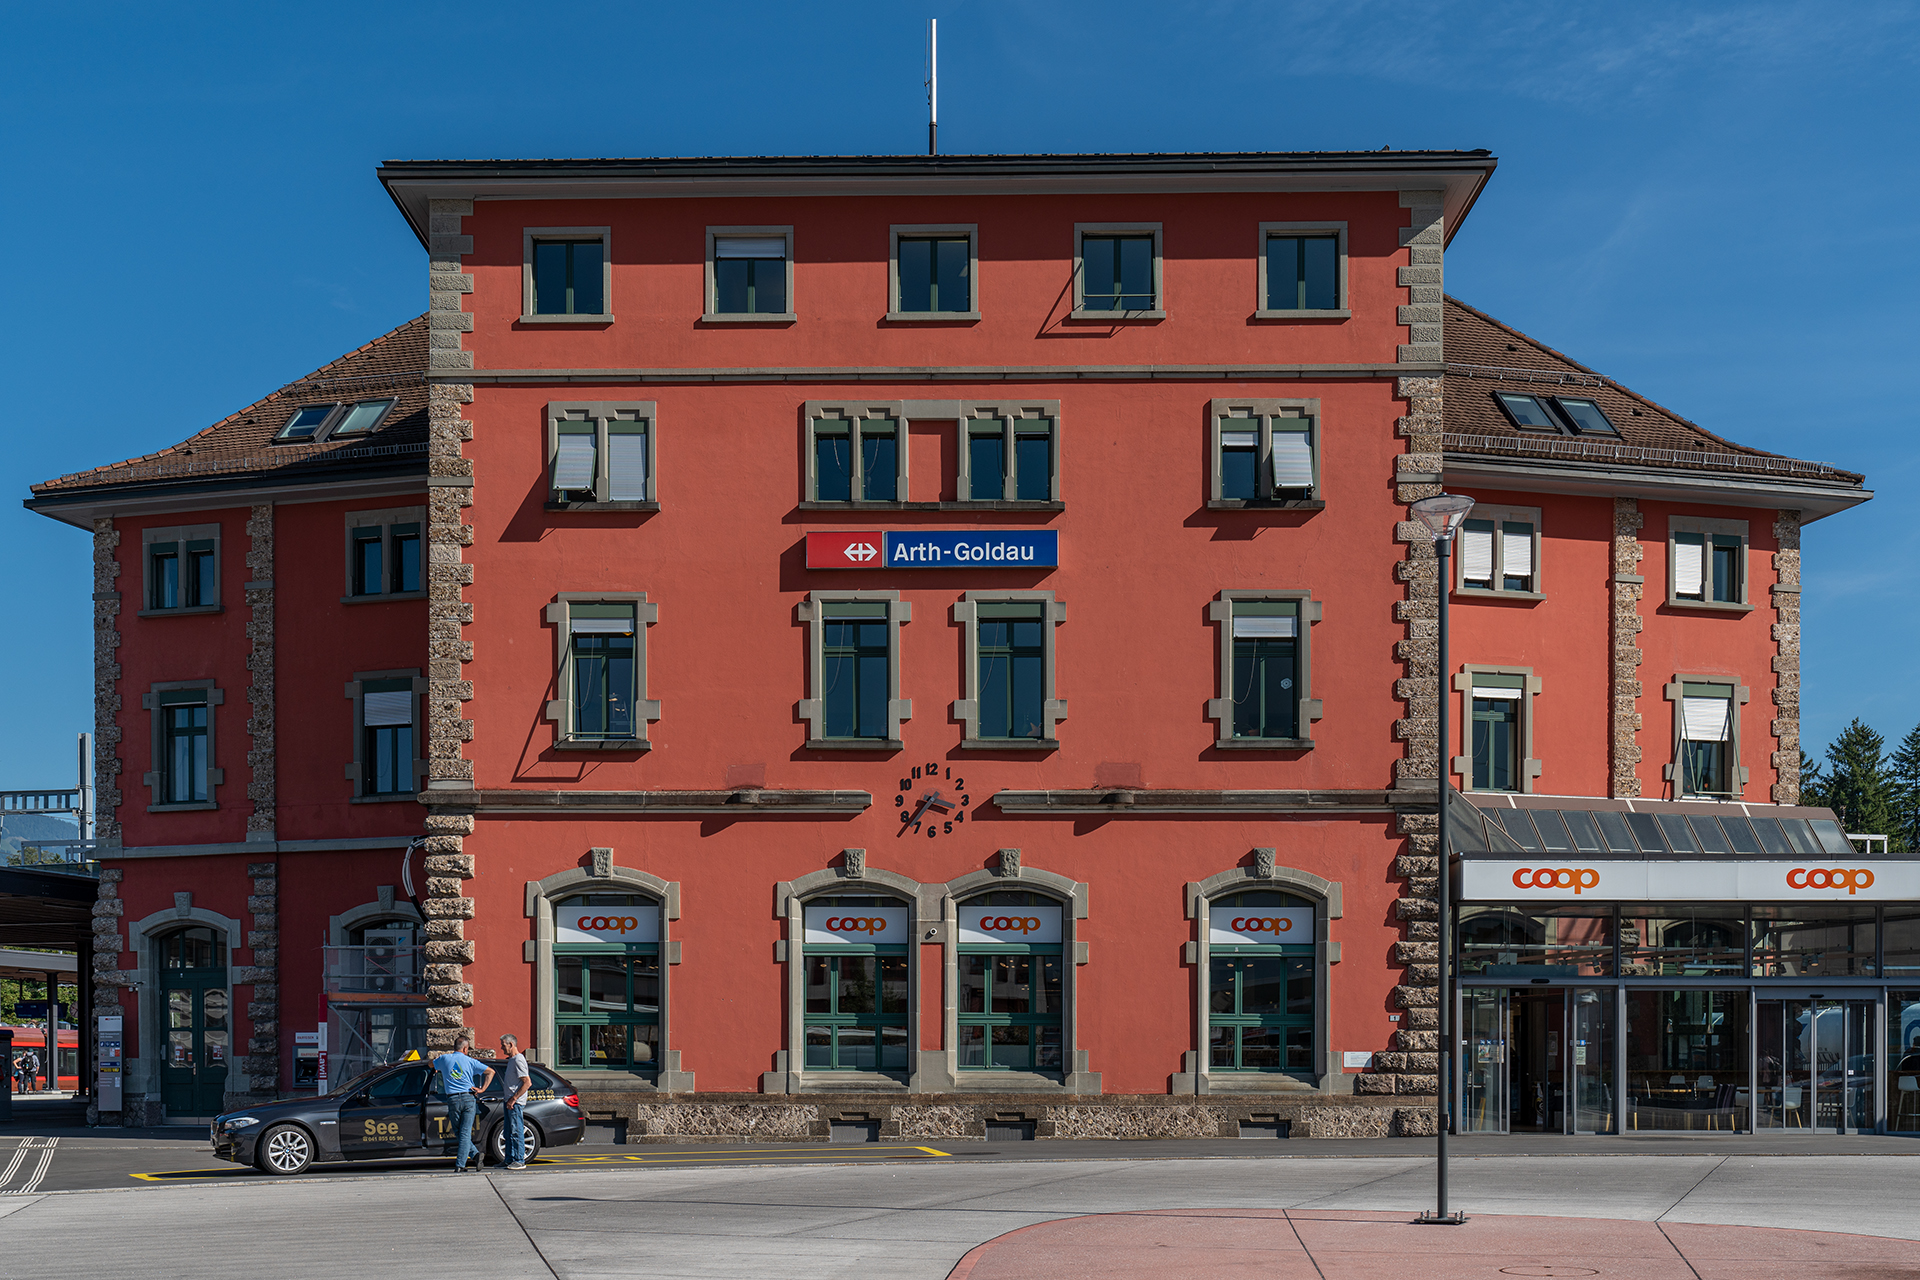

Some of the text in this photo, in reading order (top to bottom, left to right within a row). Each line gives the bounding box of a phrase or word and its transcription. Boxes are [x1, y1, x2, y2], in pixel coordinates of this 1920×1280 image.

[893, 542, 1034, 561] Arth-Goldau
[911, 766, 921, 779] 11
[925, 763, 938, 775] 12
[946, 767, 951, 780] 1
[899, 778, 912, 791] 10
[955, 777, 964, 790] 2
[894, 794, 904, 807] 9
[961, 794, 969, 806] 3
[900, 810, 909, 823] 8
[954, 810, 964, 823] 4
[913, 821, 921, 834] 7
[927, 825, 937, 838] 6
[943, 821, 953, 834] 5
[1513, 868, 1600, 894] coop
[1786, 868, 1874, 894] coop
[578, 917, 637, 934] coop
[826, 918, 886, 935] coop
[980, 917, 1040, 934] coop
[1232, 918, 1292, 935] coop
[319, 1052, 327, 1078] Lawil
[364, 1119, 399, 1135] See
[434, 1114, 480, 1133] TAI
